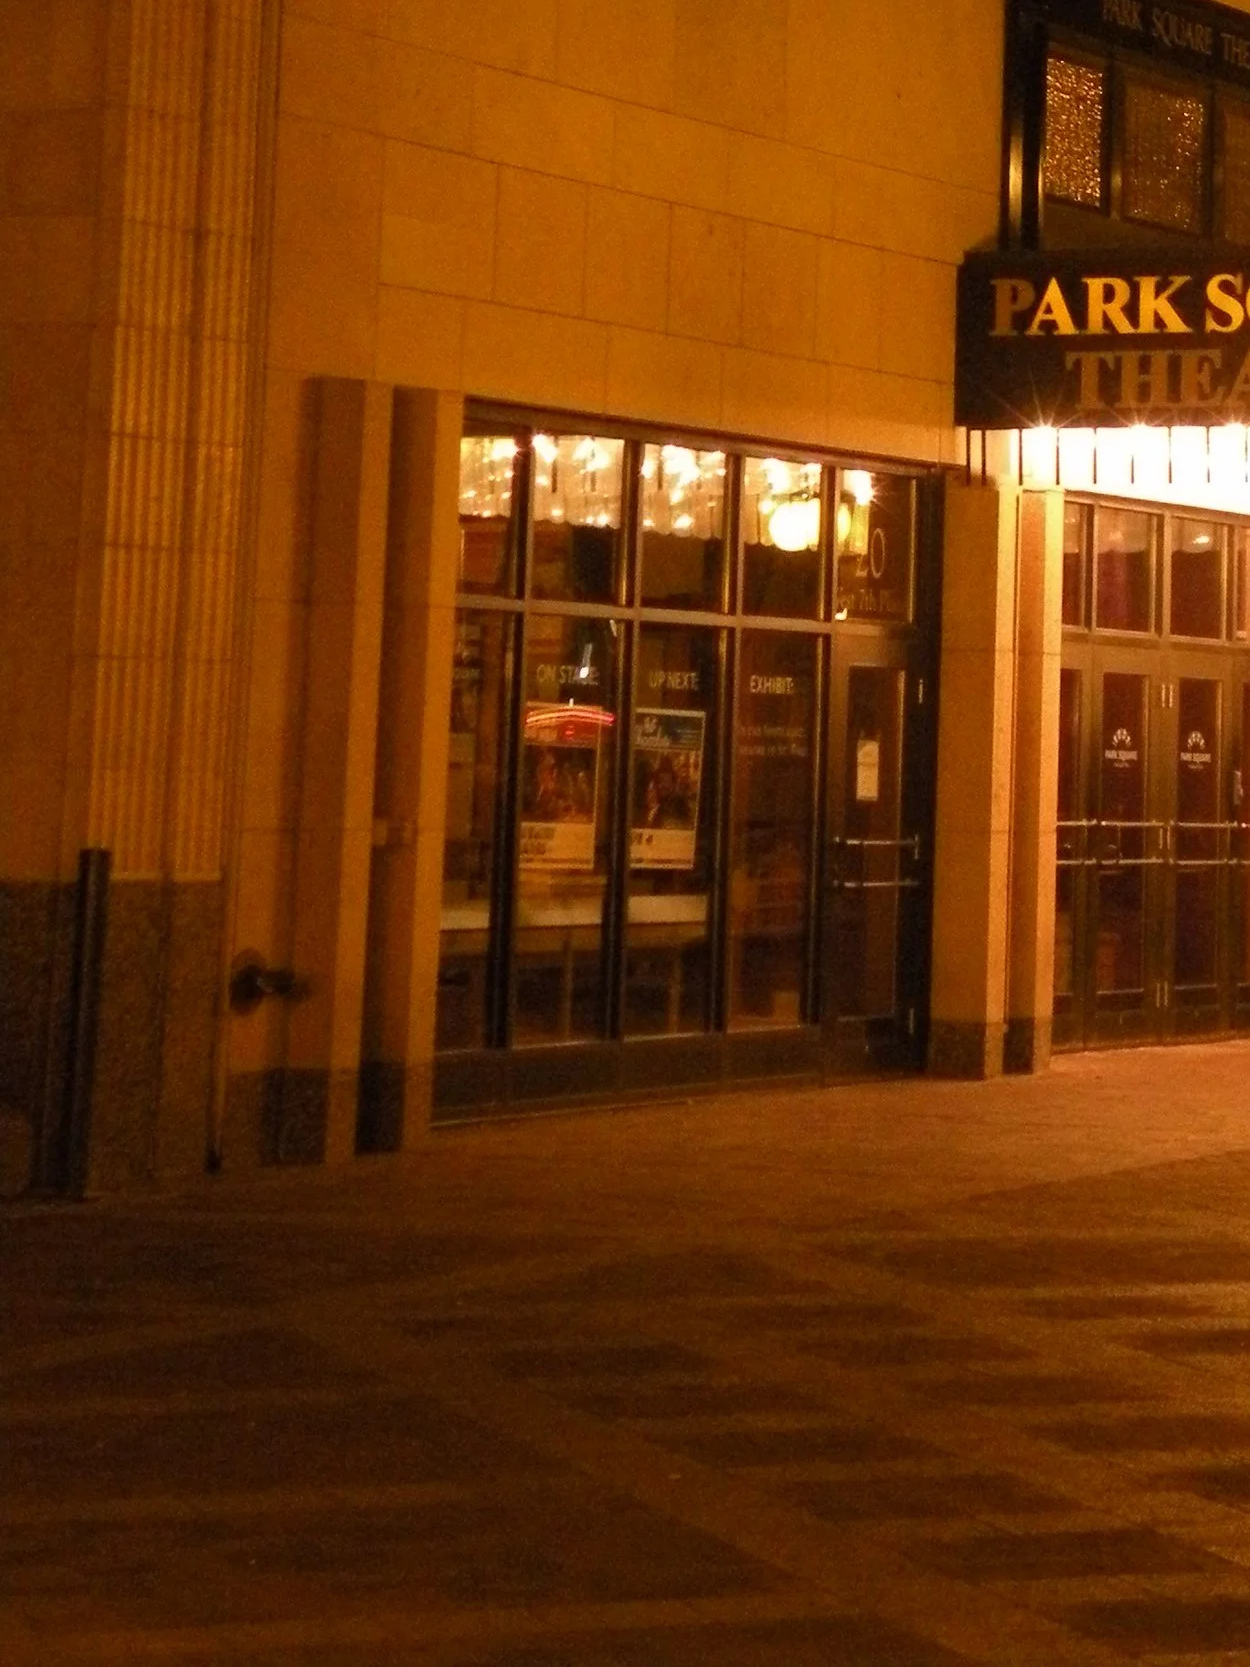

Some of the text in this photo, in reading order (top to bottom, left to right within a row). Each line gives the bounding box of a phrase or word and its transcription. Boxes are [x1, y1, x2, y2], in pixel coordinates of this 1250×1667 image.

[1152, 7, 1214, 55] SQUARE
[988, 275, 1195, 337] PARK
[536, 663, 558, 684] ON
[648, 669, 666, 689] UP
